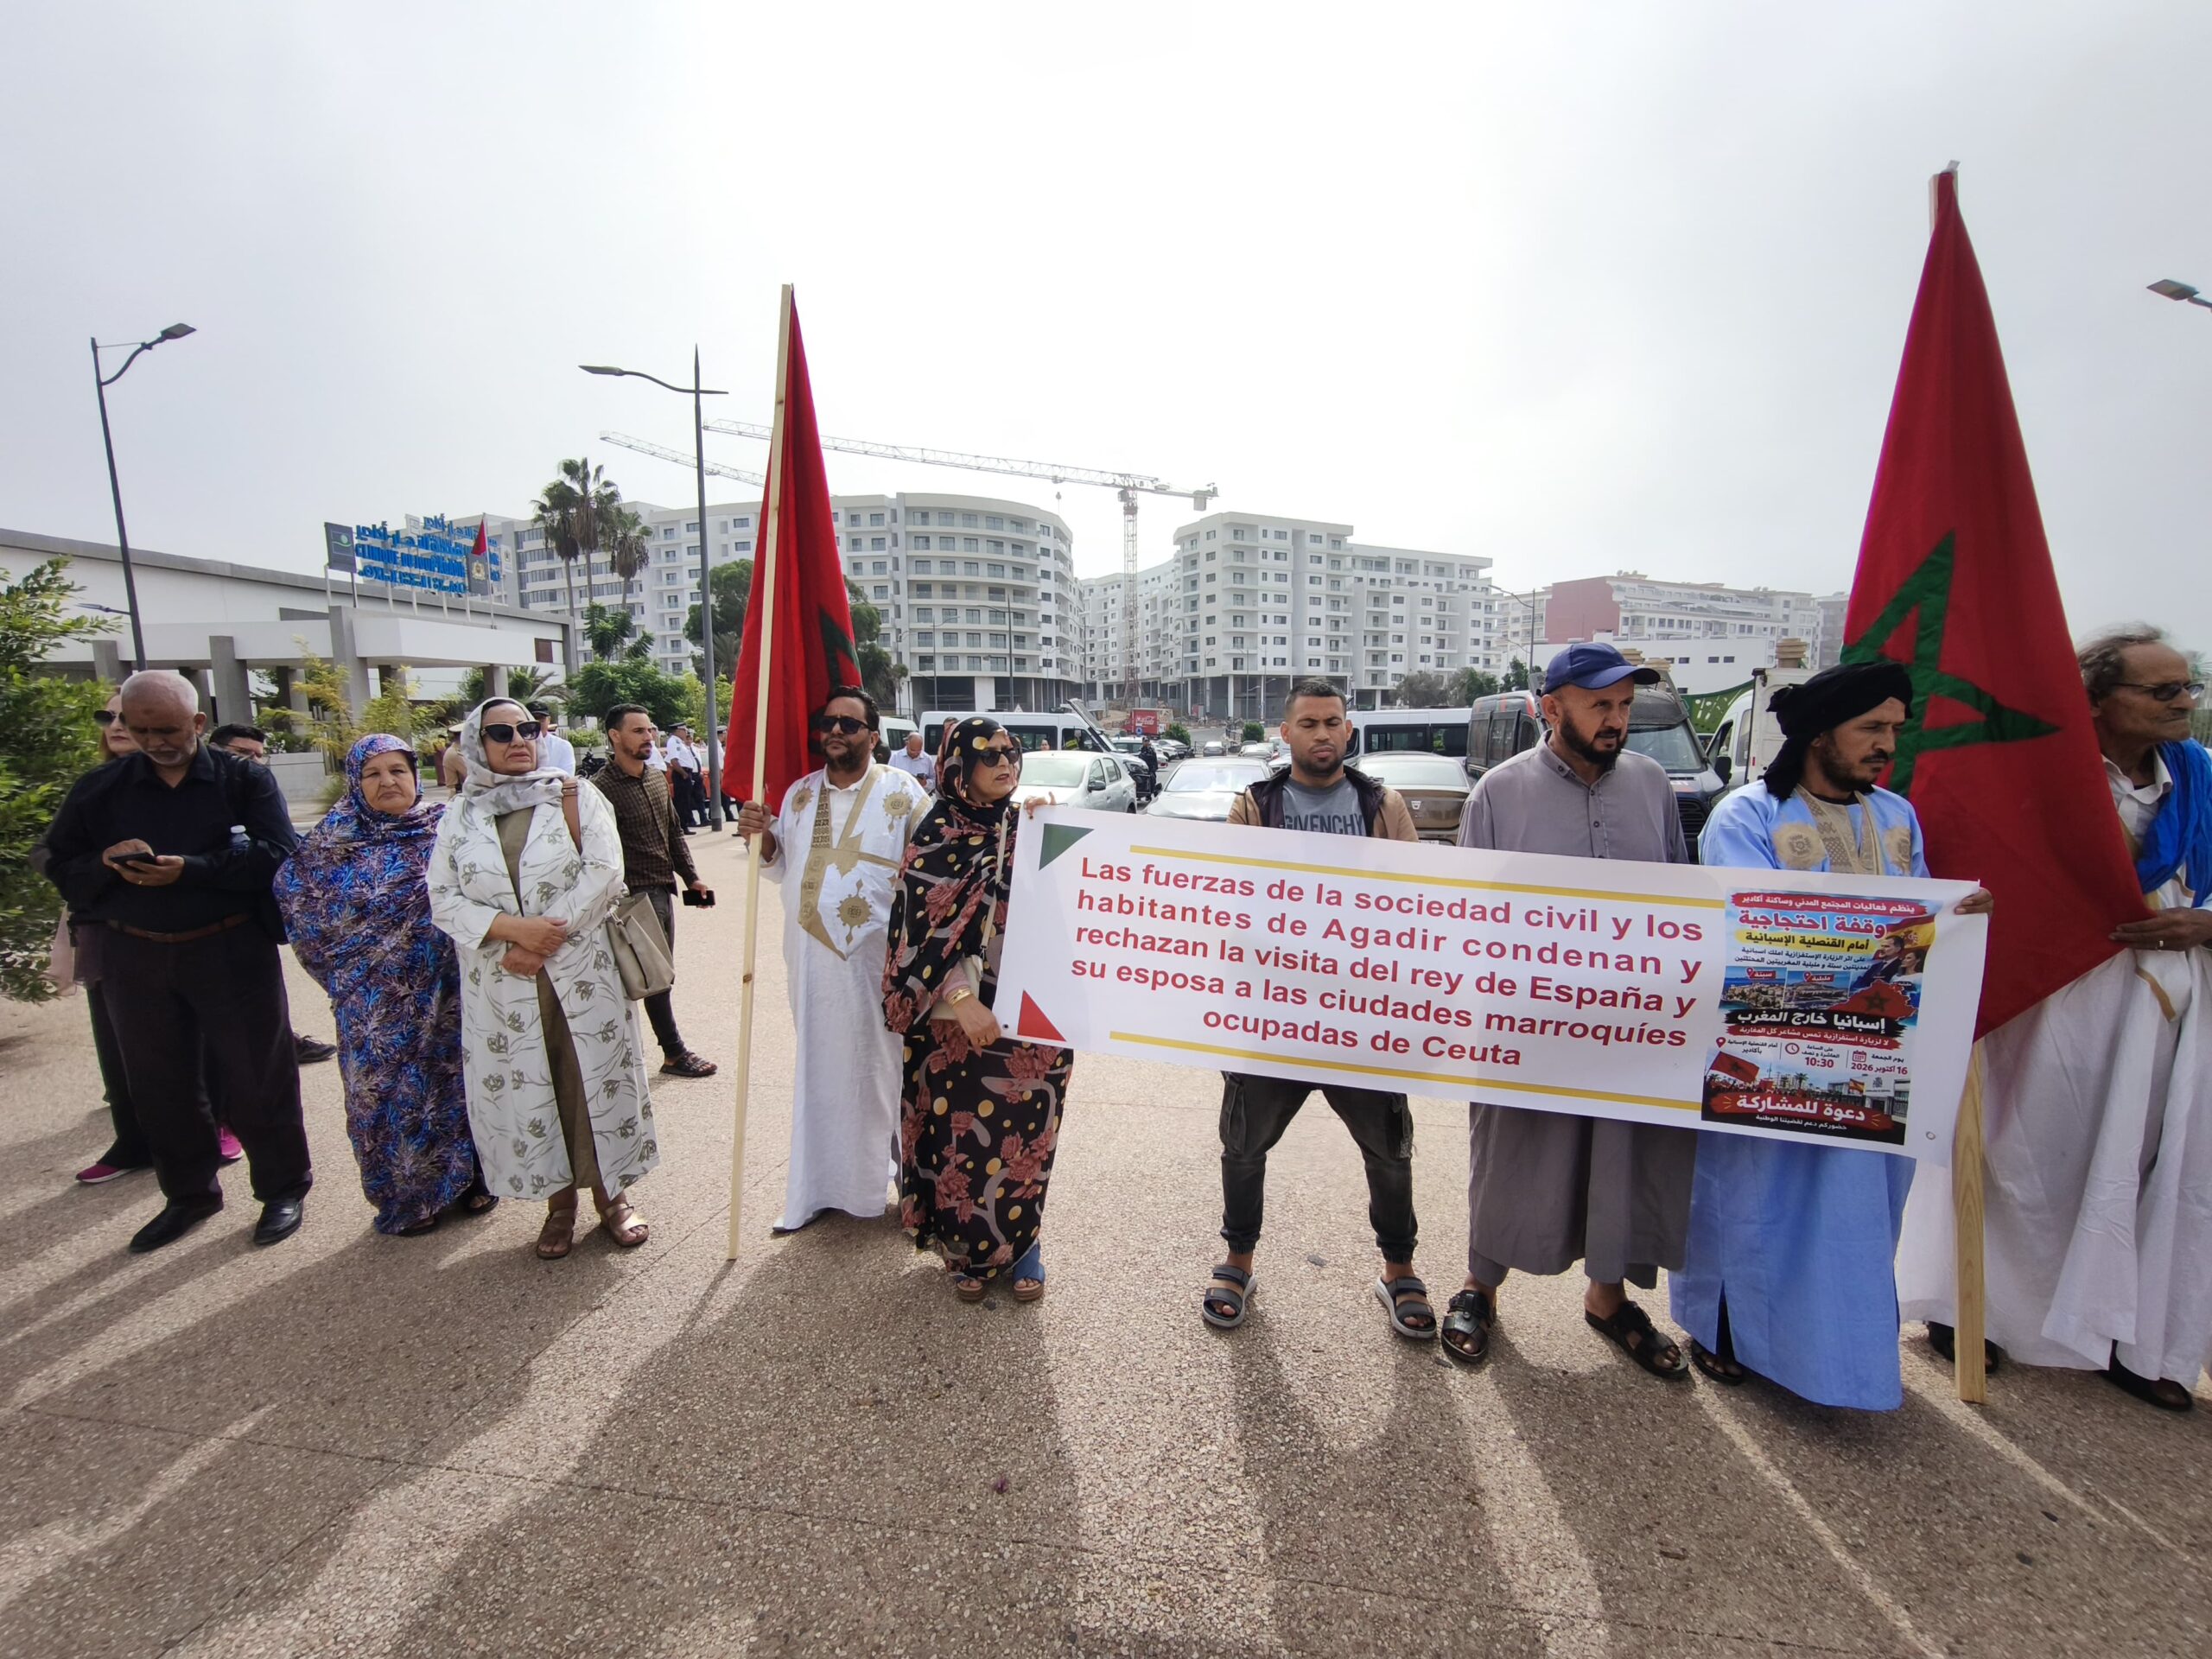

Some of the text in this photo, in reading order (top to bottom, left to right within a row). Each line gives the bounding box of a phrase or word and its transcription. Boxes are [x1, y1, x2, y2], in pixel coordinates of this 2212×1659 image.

[1285, 812, 1365, 836] GIVENCHY
[1081, 856, 1702, 941] Las fuerzas de la sociedad civil y los
[1742, 894, 1764, 904] أكادير
[1765, 895, 1793, 906] وساكنة
[1795, 899, 1819, 908] المدني
[1821, 899, 1851, 910] المجتمع
[1853, 901, 1887, 912] فعاليات
[1738, 910, 1887, 938] وقفة احتجاجية
[1077, 889, 1701, 984] habitantes de Agadir condenan y
[1745, 932, 1870, 951] أمام القنصلية الإسبانية
[1076, 925, 1697, 1019] rechazan la visita del rey de España y
[1071, 958, 1687, 1047] su esposa a las ciudades marroquíes
[1738, 1009, 1886, 1034] إسبانيا خارج المغرب
[1739, 1026, 1766, 1035] المغاربة
[1766, 1027, 1777, 1036] كل
[1778, 1028, 1801, 1038] مشاعر
[1203, 1011, 1521, 1065] ocupadas de Ceuta
[1824, 1033, 1859, 1043] استفزازية
[1804, 1057, 1834, 1068] 10:30
[1872, 1053, 1891, 1062] الجمعة
[1851, 1063, 1873, 1071] 2026
[1897, 1066, 1908, 1075] 16
[1736, 1094, 1866, 1122] دعوة للمشاركة
